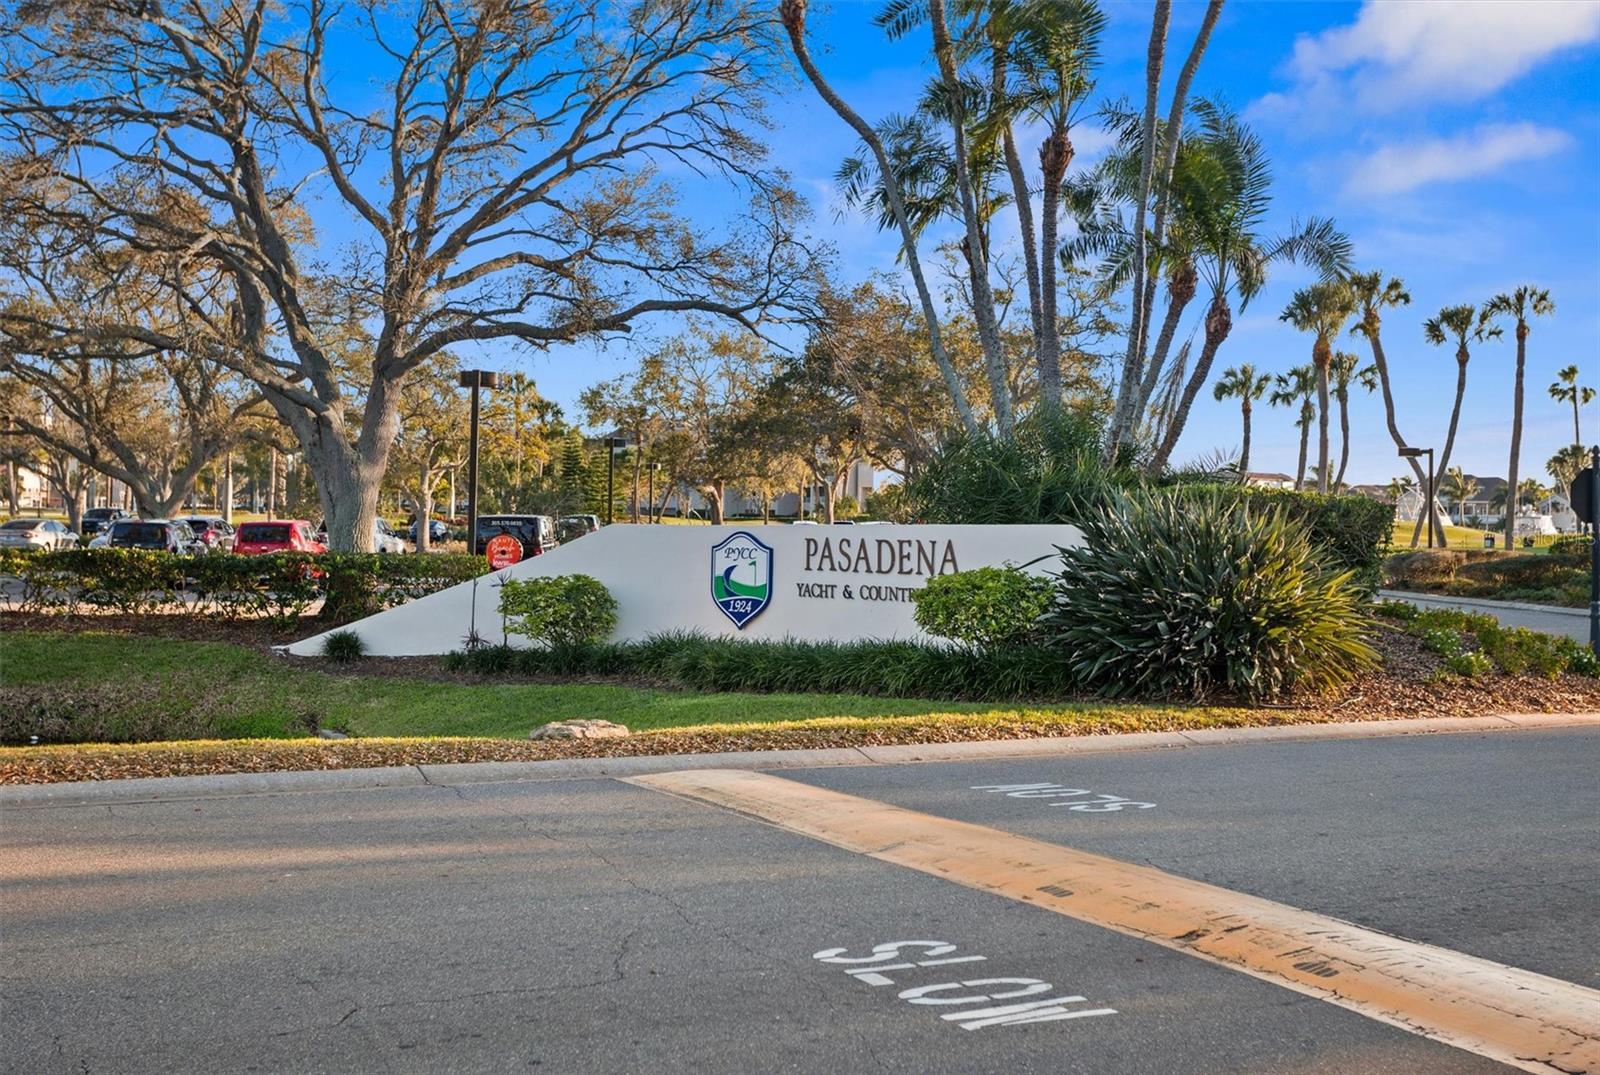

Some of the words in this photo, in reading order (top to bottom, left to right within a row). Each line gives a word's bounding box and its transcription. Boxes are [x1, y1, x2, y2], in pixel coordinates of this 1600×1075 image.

[724, 547, 757, 561] PYCC
[804, 537, 960, 576] PASADENA
[796, 583, 837, 599] YACHT
[843, 585, 855, 600] &
[728, 599, 752, 613] 1924
[813, 940, 1118, 1031] SLOW
